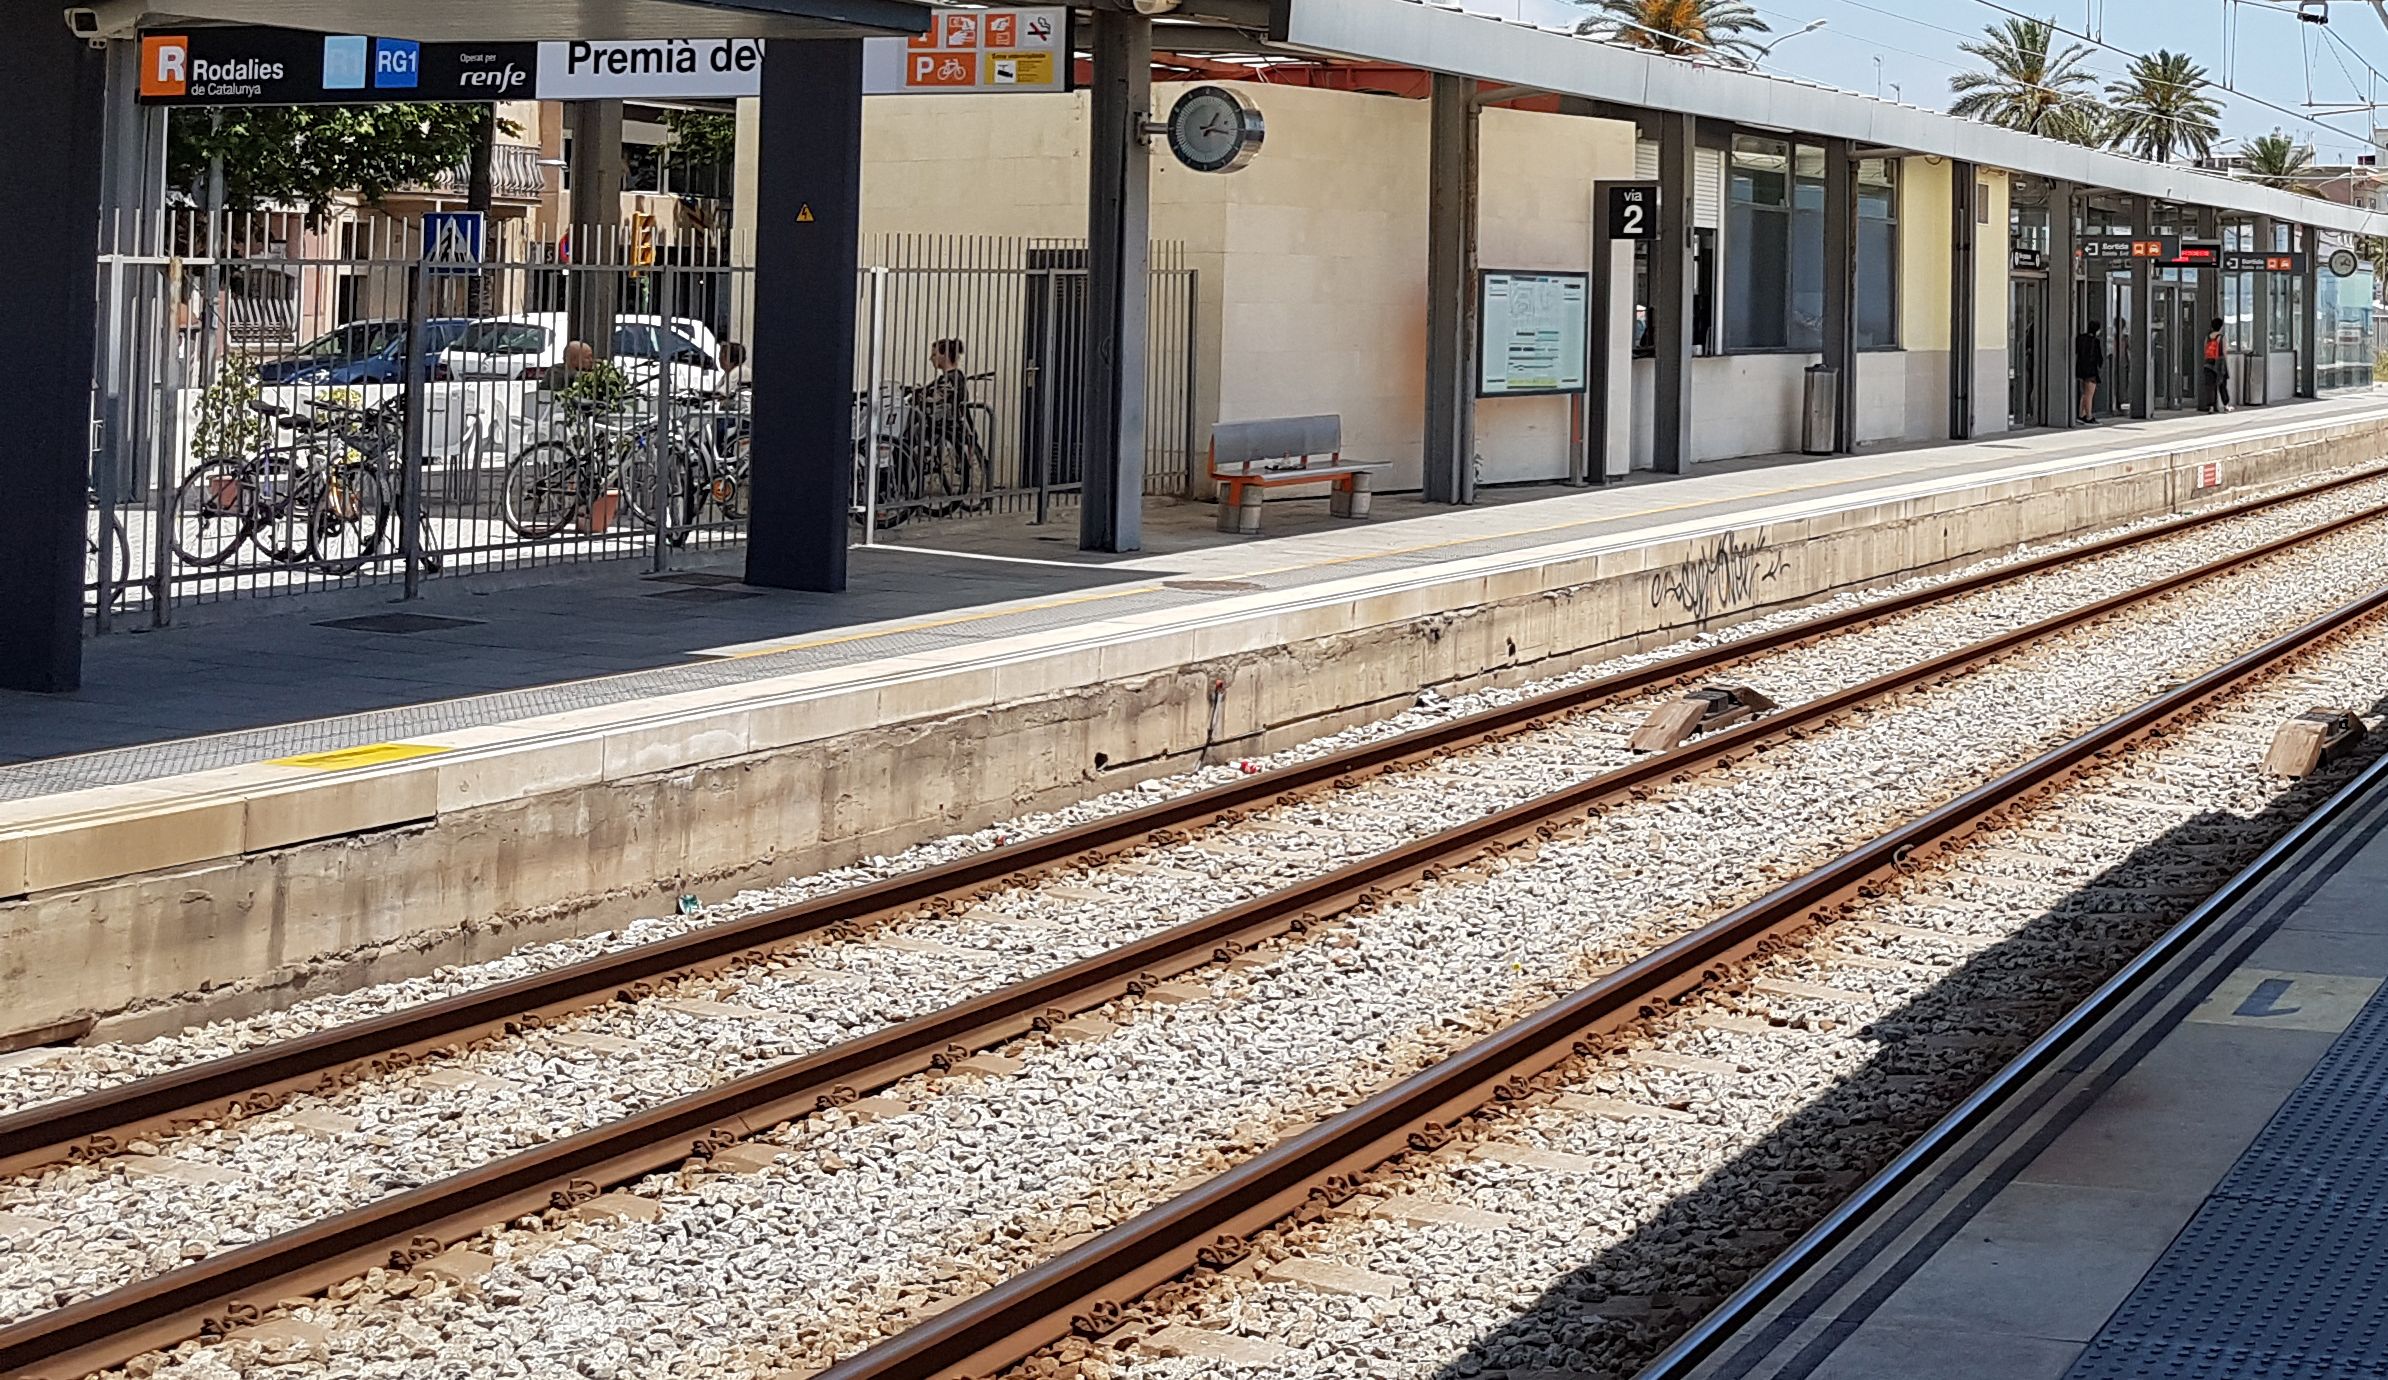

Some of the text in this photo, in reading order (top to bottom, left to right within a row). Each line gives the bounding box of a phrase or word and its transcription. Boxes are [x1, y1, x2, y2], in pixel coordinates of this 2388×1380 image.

[157, 45, 185, 82] R
[193, 59, 284, 81] Rodalies
[378, 50, 417, 73] RG1
[460, 53, 497, 63] Operat per
[568, 39, 756, 75] Premià de
[916, 56, 934, 82] P
[191, 83, 262, 97] de Catalunya
[459, 62, 527, 94] renfe
[1623, 205, 1643, 233] 2
